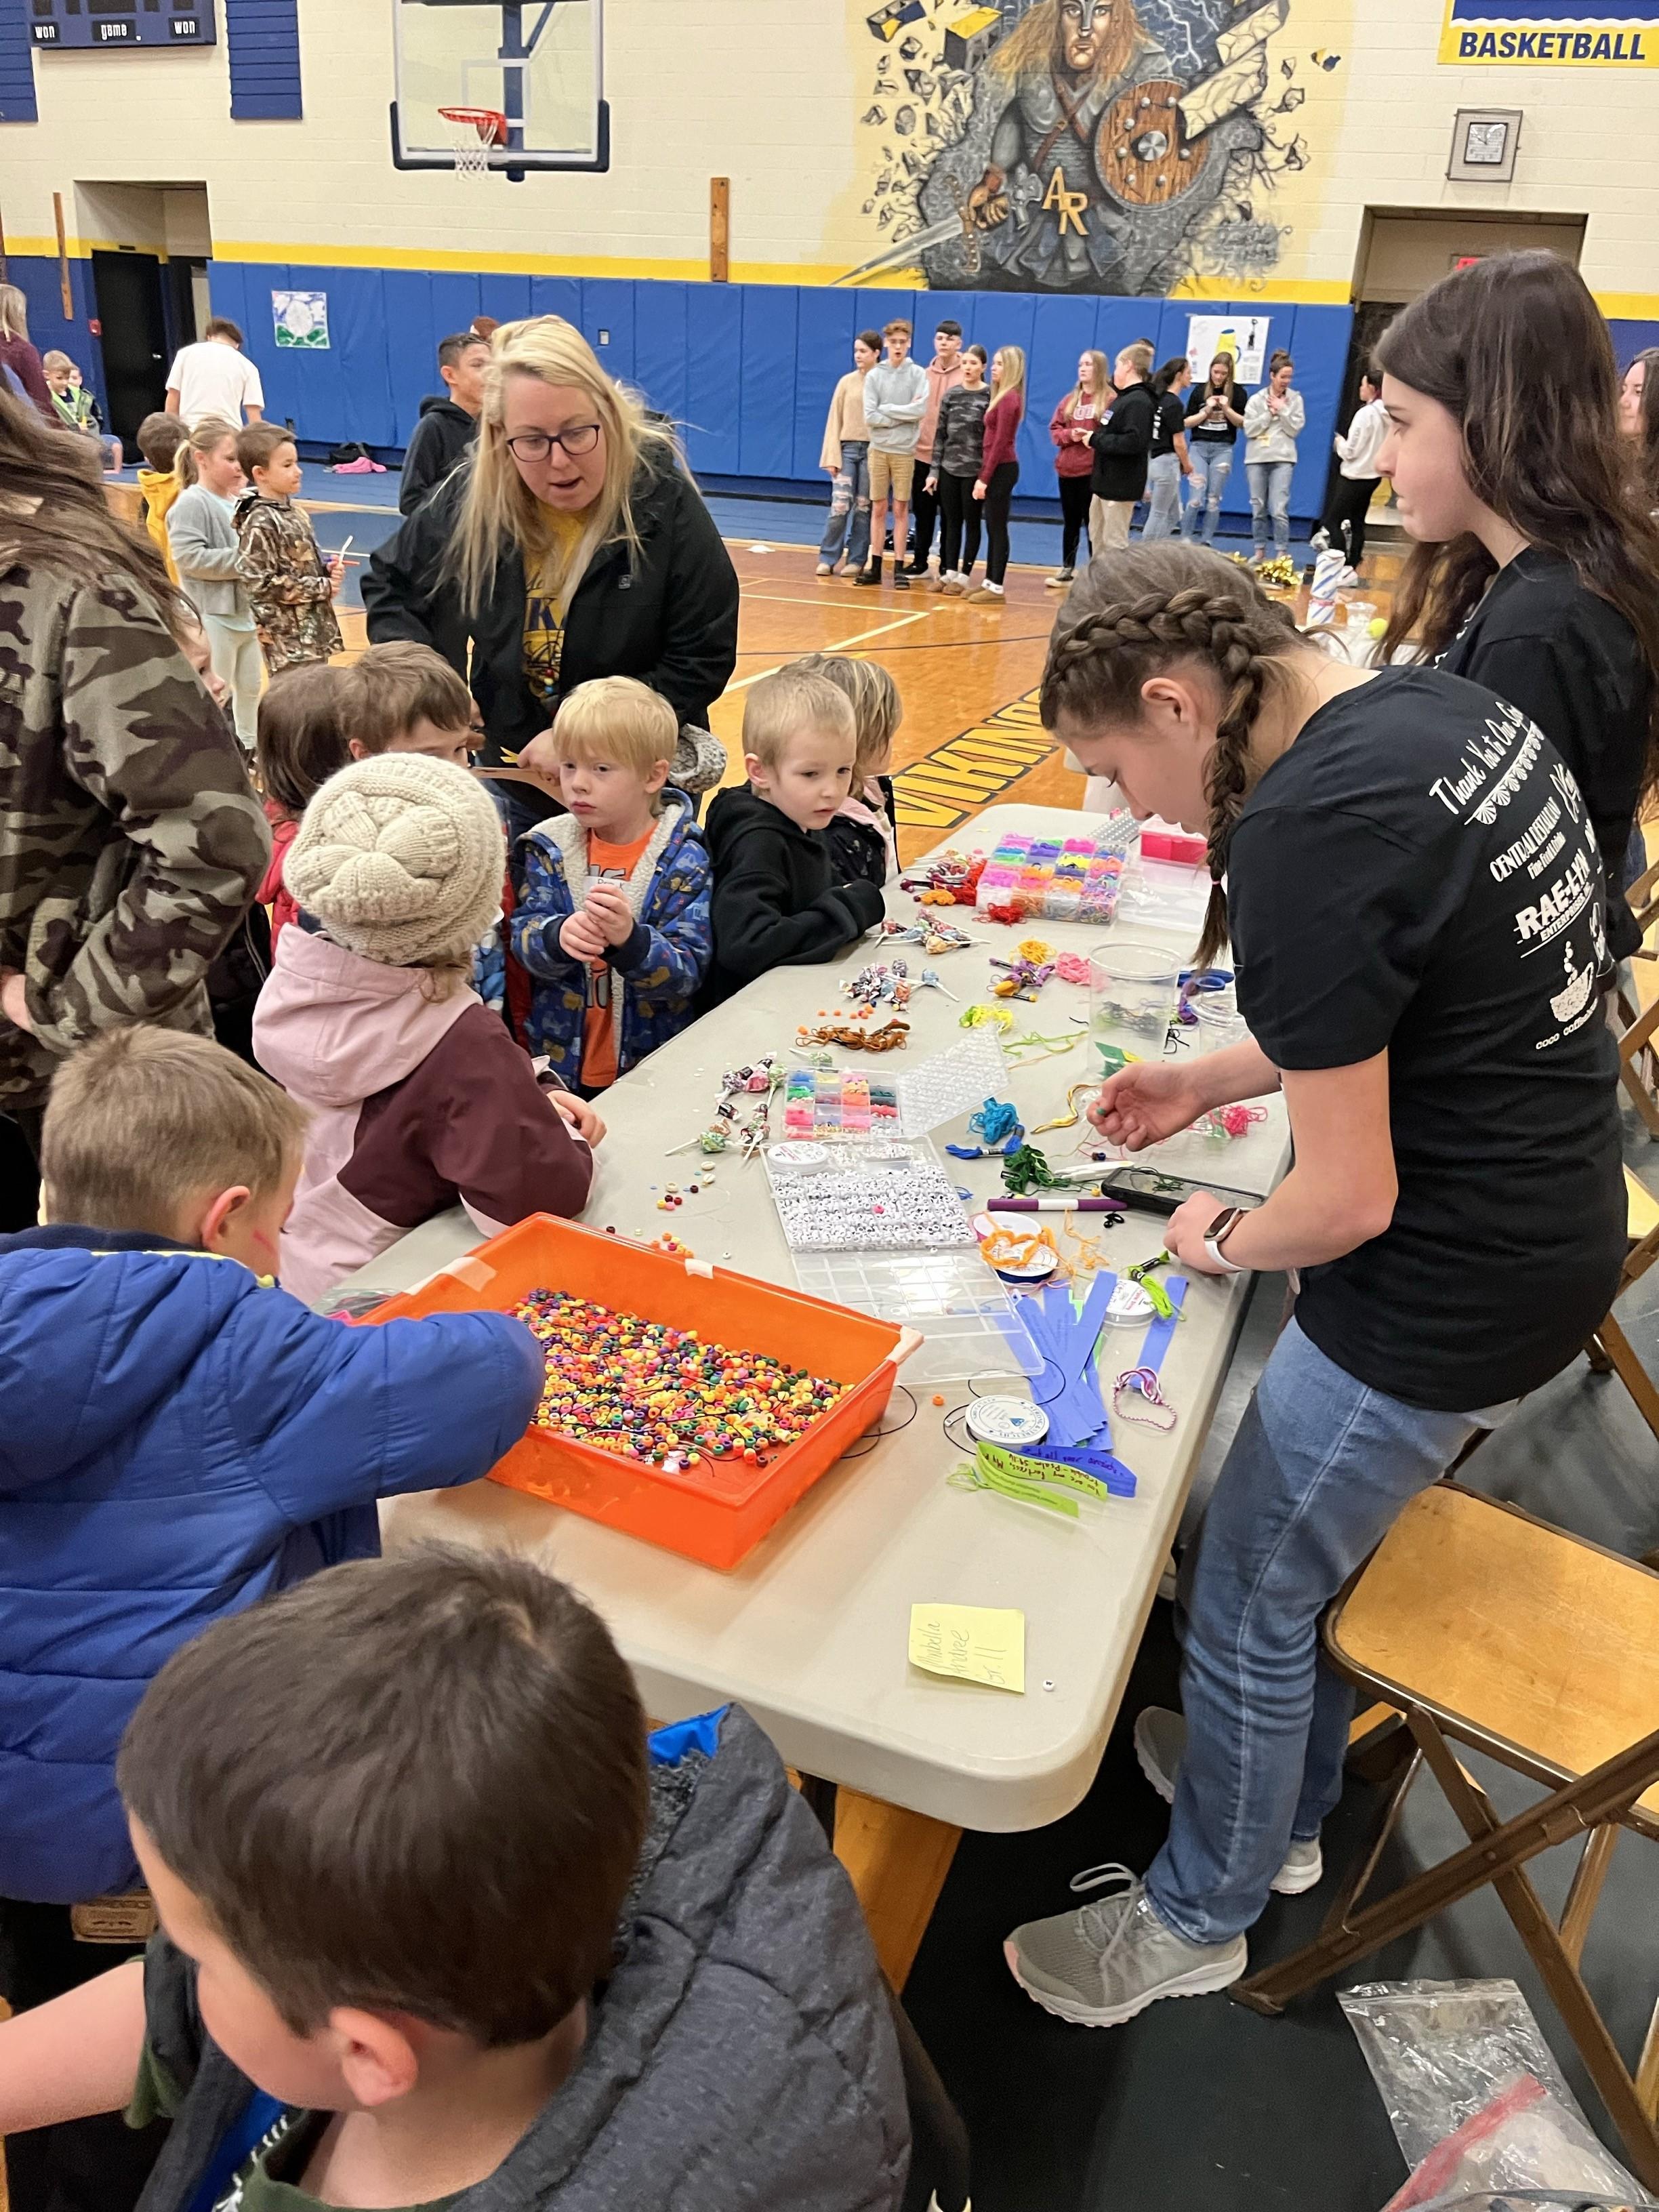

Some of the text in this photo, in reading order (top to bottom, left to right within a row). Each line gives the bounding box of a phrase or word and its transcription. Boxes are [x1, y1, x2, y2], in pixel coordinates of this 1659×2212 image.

[35, 26, 56, 39] won
[100, 23, 128, 41] game
[174, 21, 196, 34] won
[1458, 32, 1645, 60] BASKETBALL
[1429, 757, 1487, 815] Thank
[1465, 739, 1501, 770] You
[1490, 832, 1539, 882] CENTRAL
